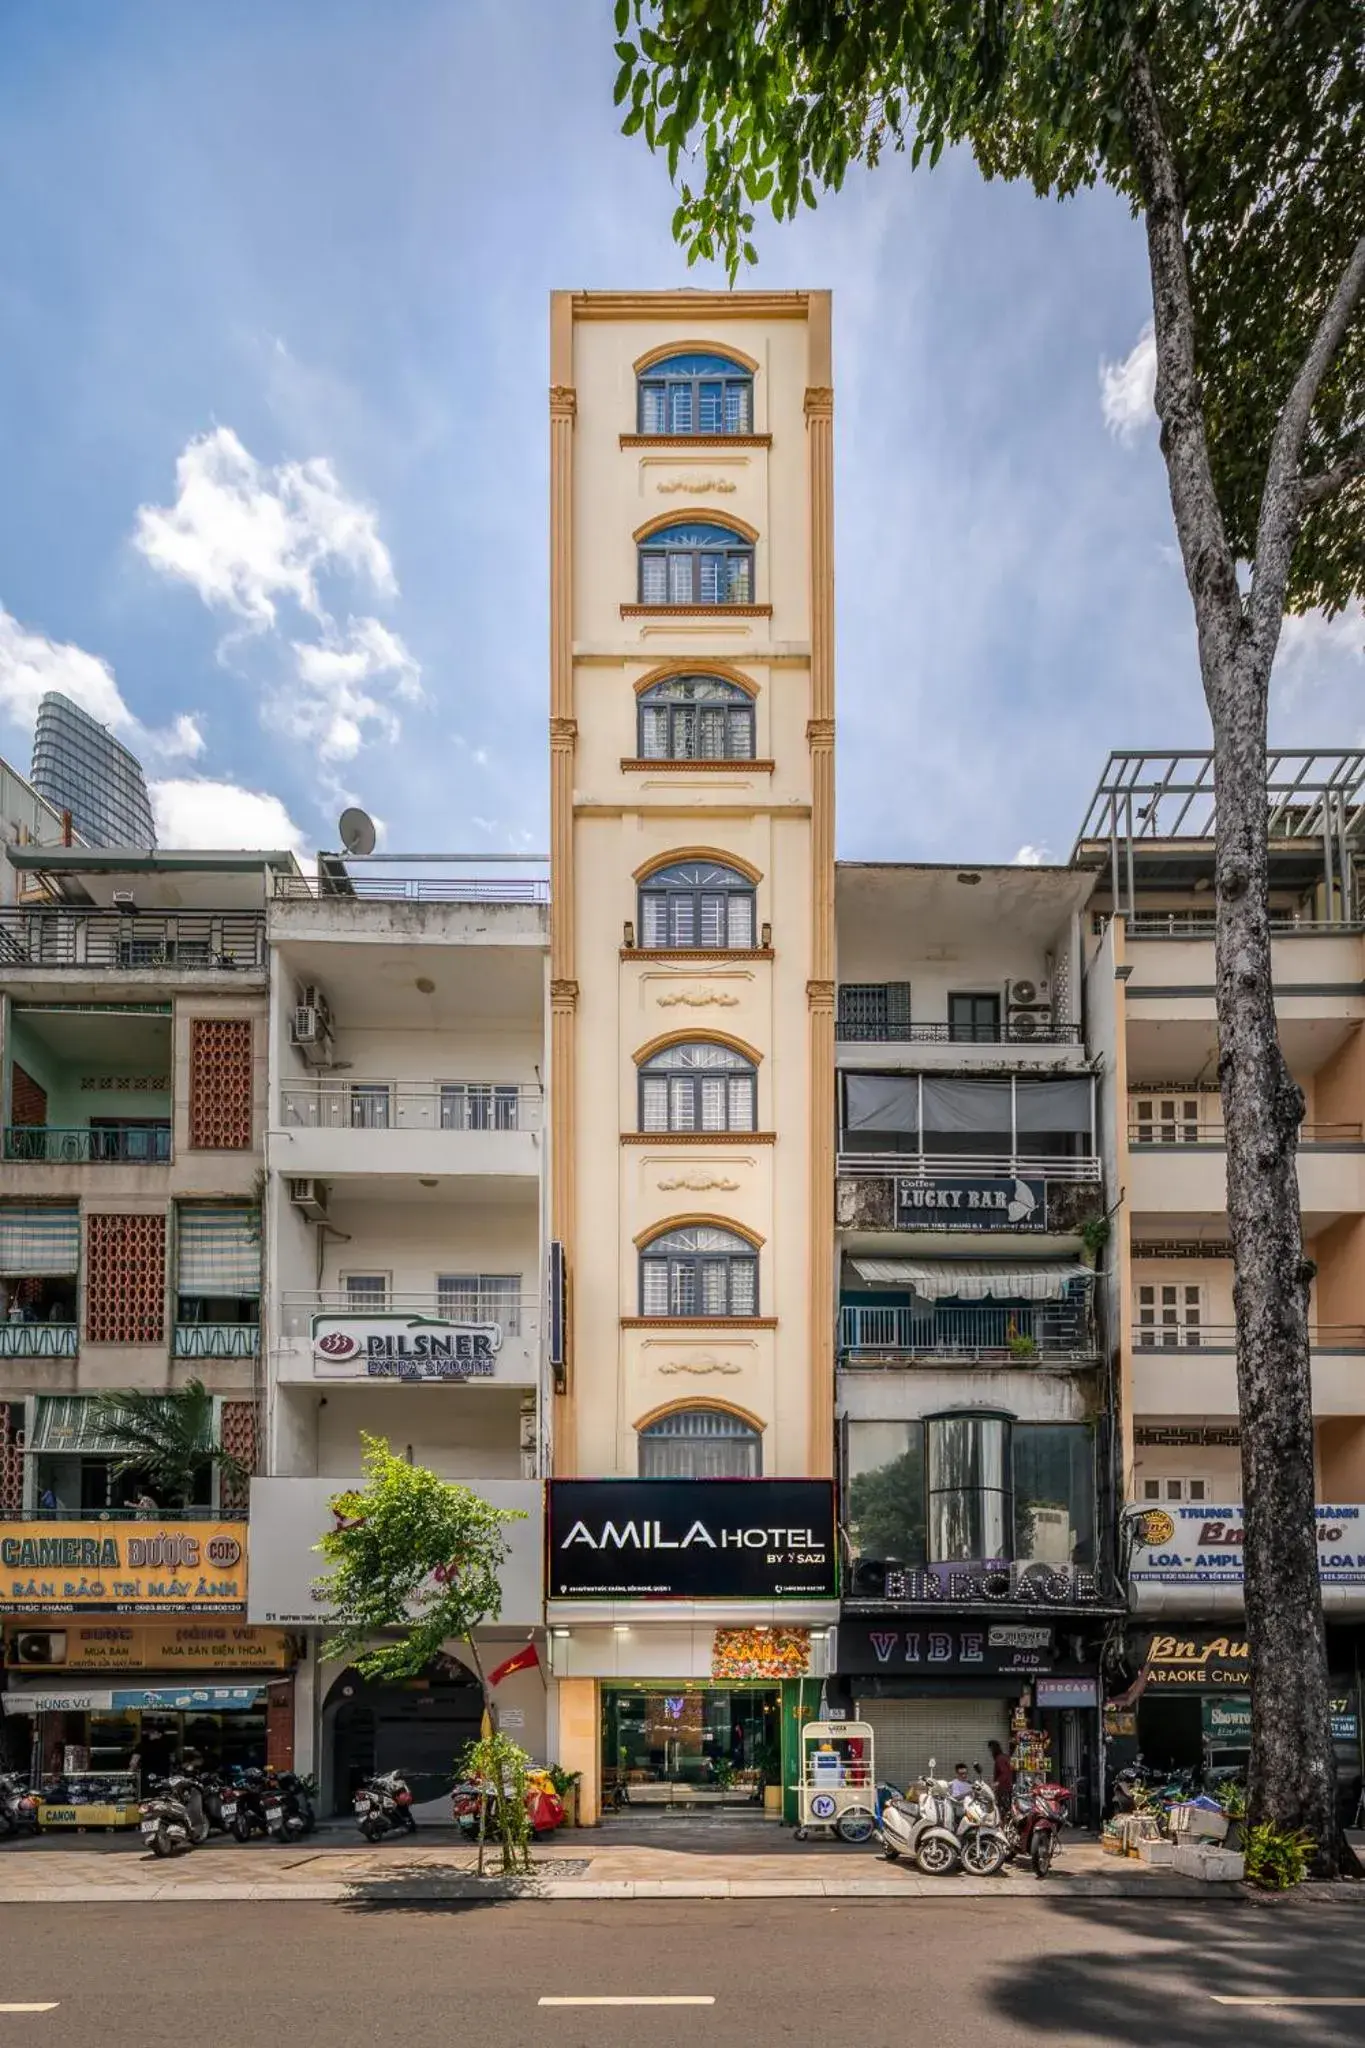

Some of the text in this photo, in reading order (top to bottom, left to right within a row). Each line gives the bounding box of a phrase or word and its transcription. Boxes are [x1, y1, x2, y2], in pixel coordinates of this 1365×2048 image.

[901, 1179, 936, 1188] Coffee
[900, 1190, 1008, 1209] LUCKY BAR
[367, 1335, 493, 1355] PILSNER
[368, 1360, 494, 1375] EXTRA SMOOTH
[1179, 1508, 1232, 1519] TRUNG
[560, 1520, 825, 1549] AMILA HOTEL
[1, 1537, 120, 1568] CAMERA
[209, 1542, 236, 1560] COM
[766, 1554, 826, 1564] BY SAZI
[1149, 1554, 1184, 1567] LOA
[1194, 1554, 1244, 1567] AMPL
[1320, 1555, 1354, 1567] LOA
[12, 1578, 55, 1597] BÁN
[63, 1576, 105, 1597] BẢO
[886, 1573, 1098, 1600] BIRDCAGE
[869, 1632, 984, 1663] VIBE
[1147, 1636, 1196, 1663] Bn
[1147, 1670, 1250, 1685] ARAOKE Chuy
[1329, 1699, 1347, 1713] 57
[1211, 1708, 1250, 1725] Showro
